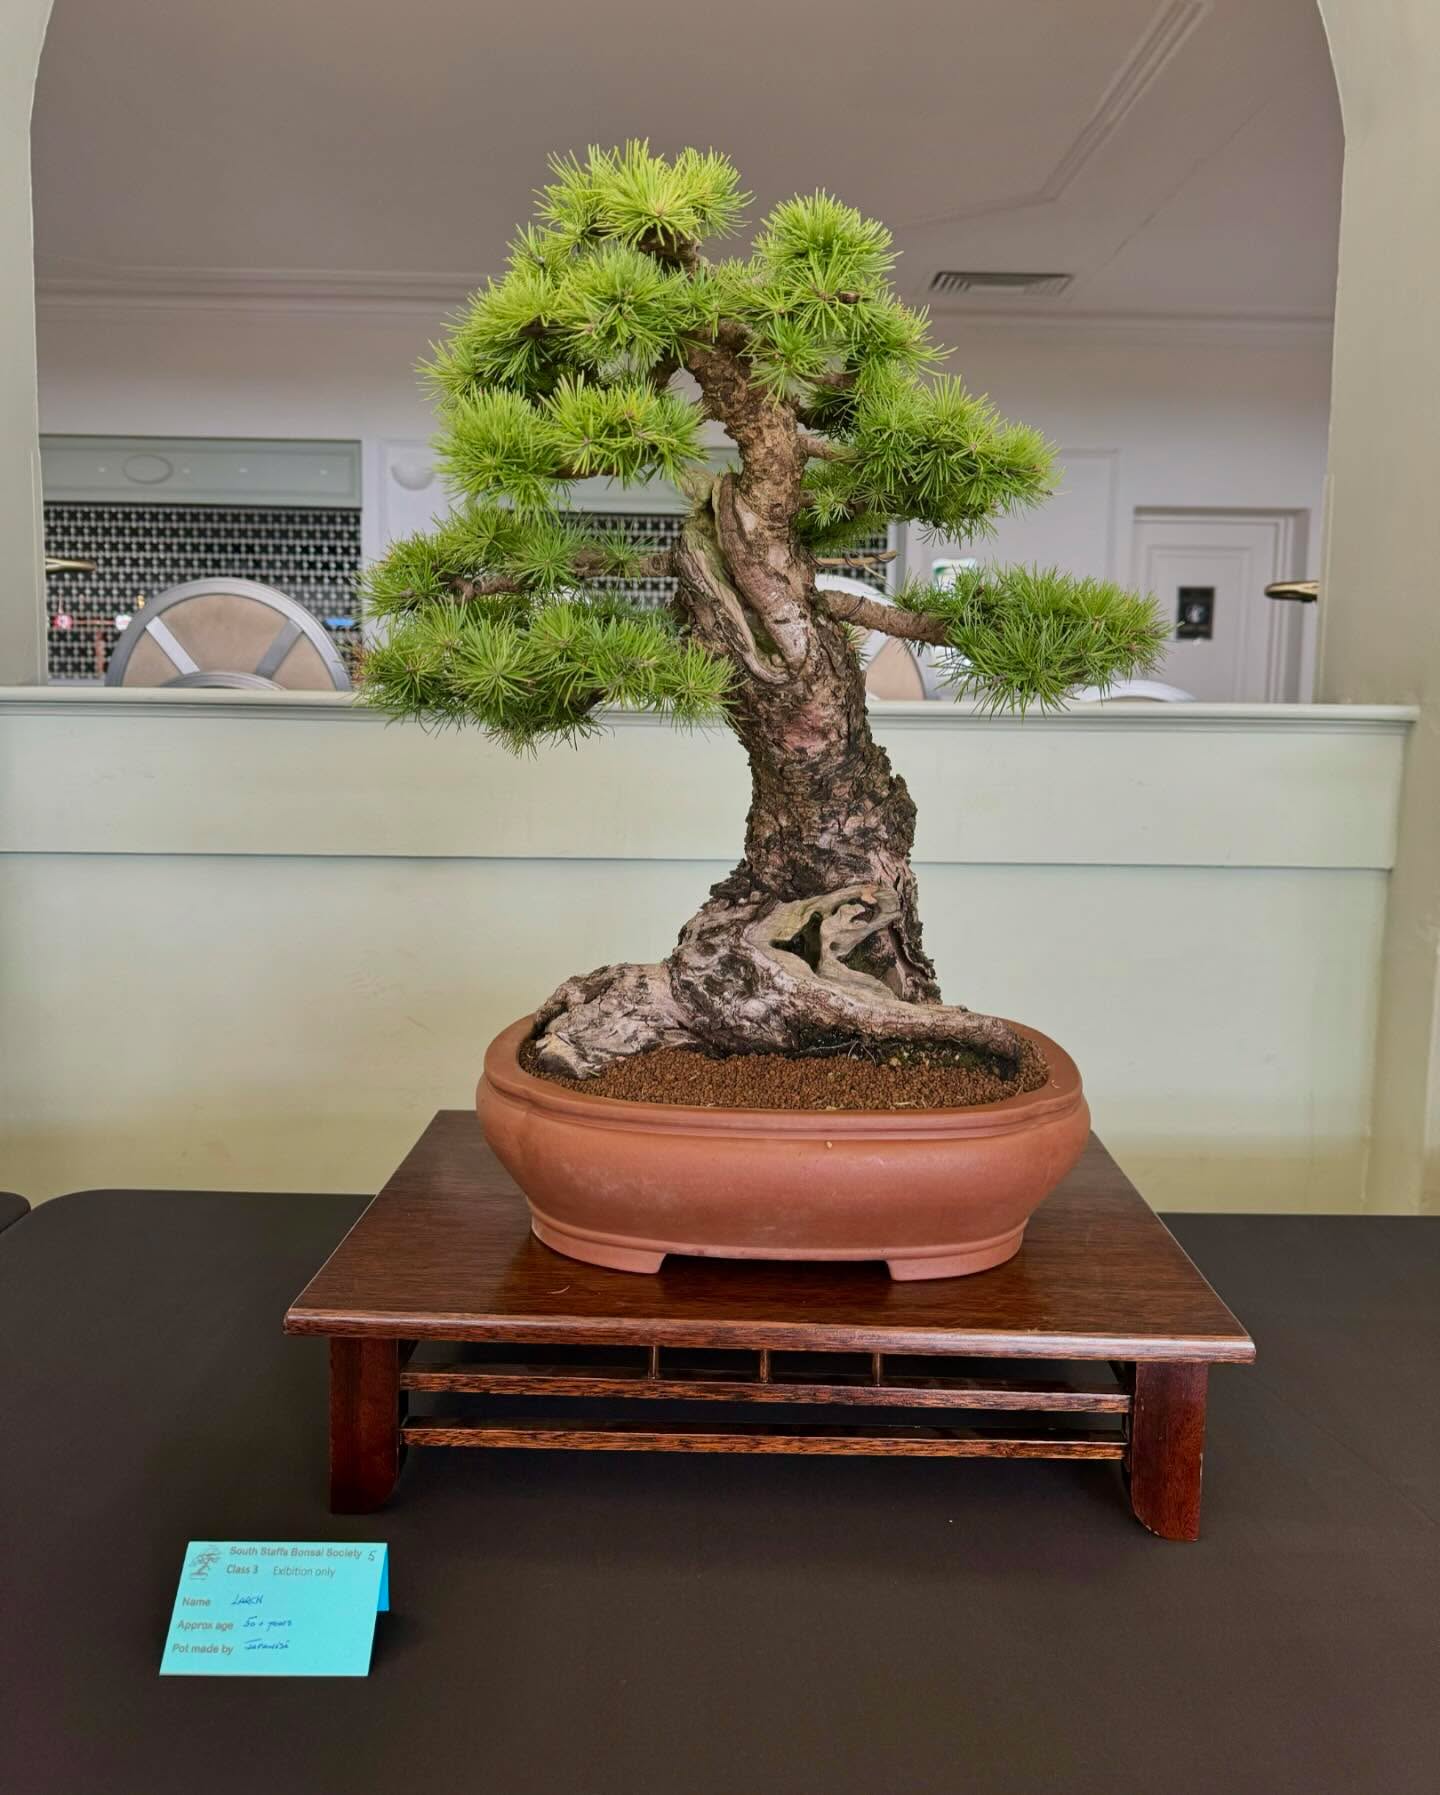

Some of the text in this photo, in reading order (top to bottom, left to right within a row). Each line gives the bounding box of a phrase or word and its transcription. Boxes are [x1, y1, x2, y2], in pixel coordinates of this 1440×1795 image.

[230, 1546, 258, 1556] South
[290, 1547, 324, 1557] Bonsai
[326, 1548, 362, 1560] Society
[226, 1564, 259, 1574] Class 3
[273, 1566, 336, 1578] Exibition only
[182, 1597, 211, 1607] Name
[177, 1620, 234, 1631] Approx age
[172, 1643, 234, 1655] Pot made by
